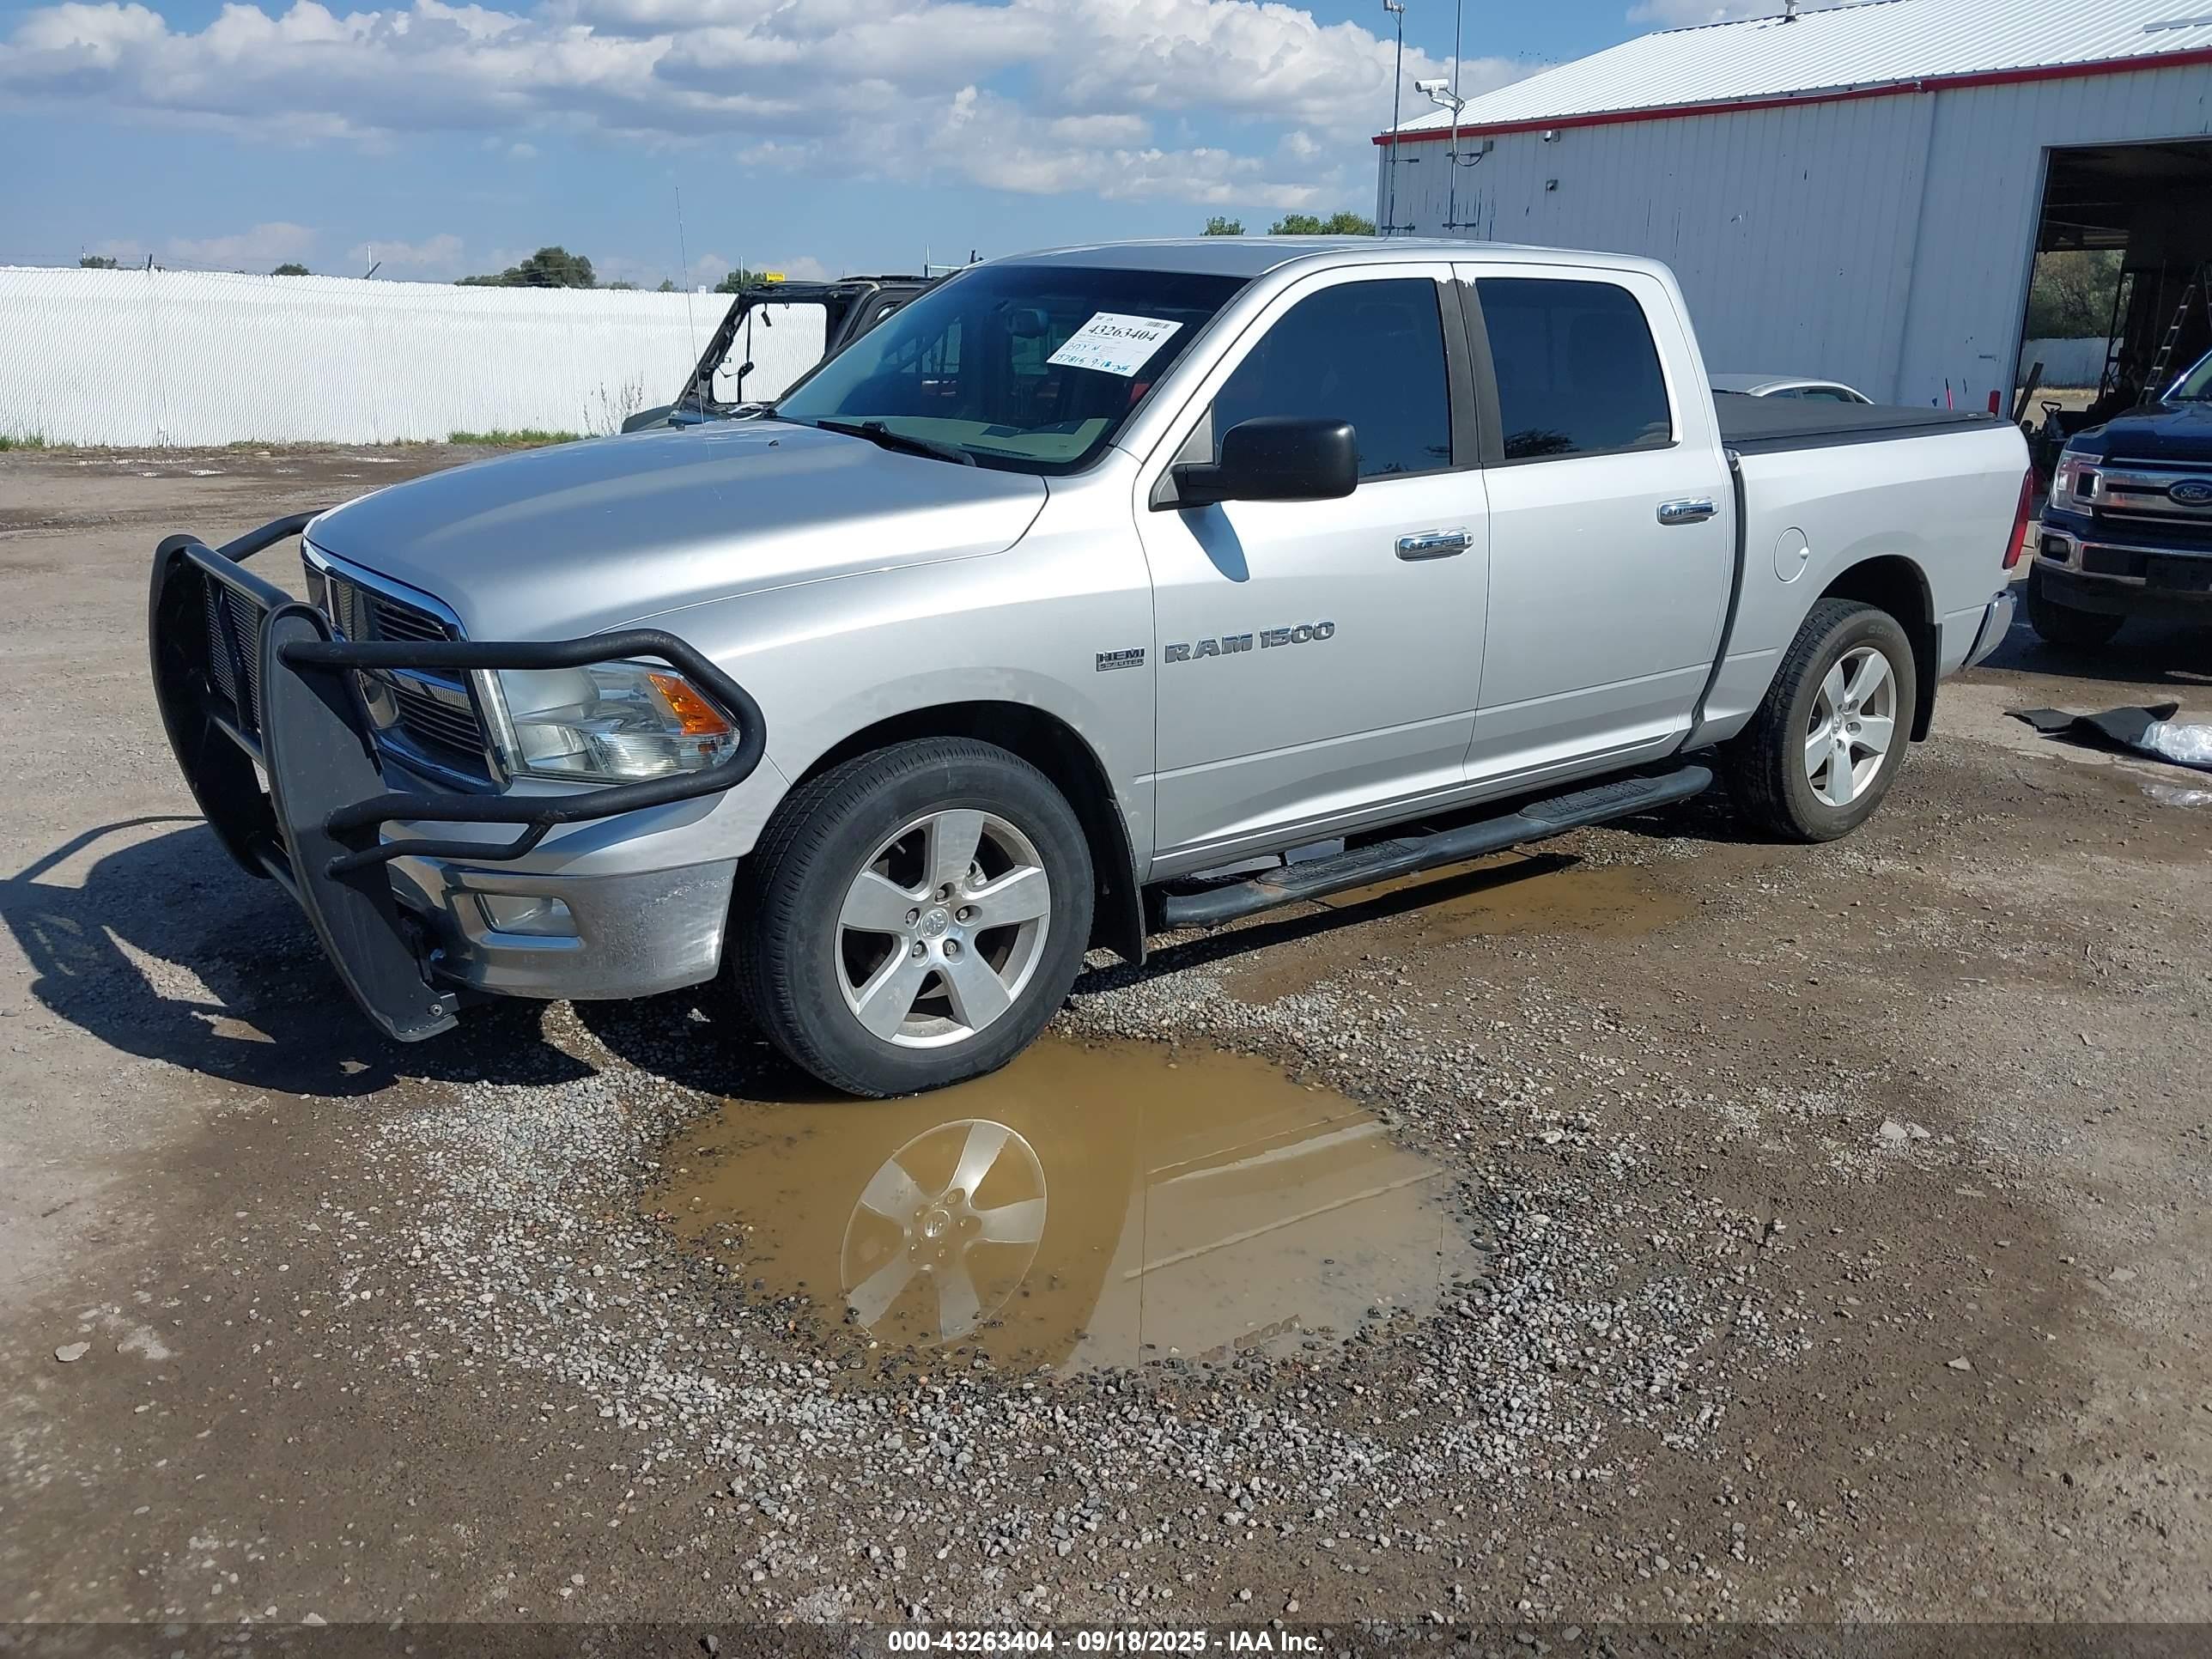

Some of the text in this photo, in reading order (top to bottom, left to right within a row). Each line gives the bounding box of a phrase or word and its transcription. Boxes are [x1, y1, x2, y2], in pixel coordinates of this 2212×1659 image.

[1088, 324, 1160, 342] 43263404
[1164, 620, 1335, 664] RAM 1500
[1099, 647, 1145, 662] HEMI
